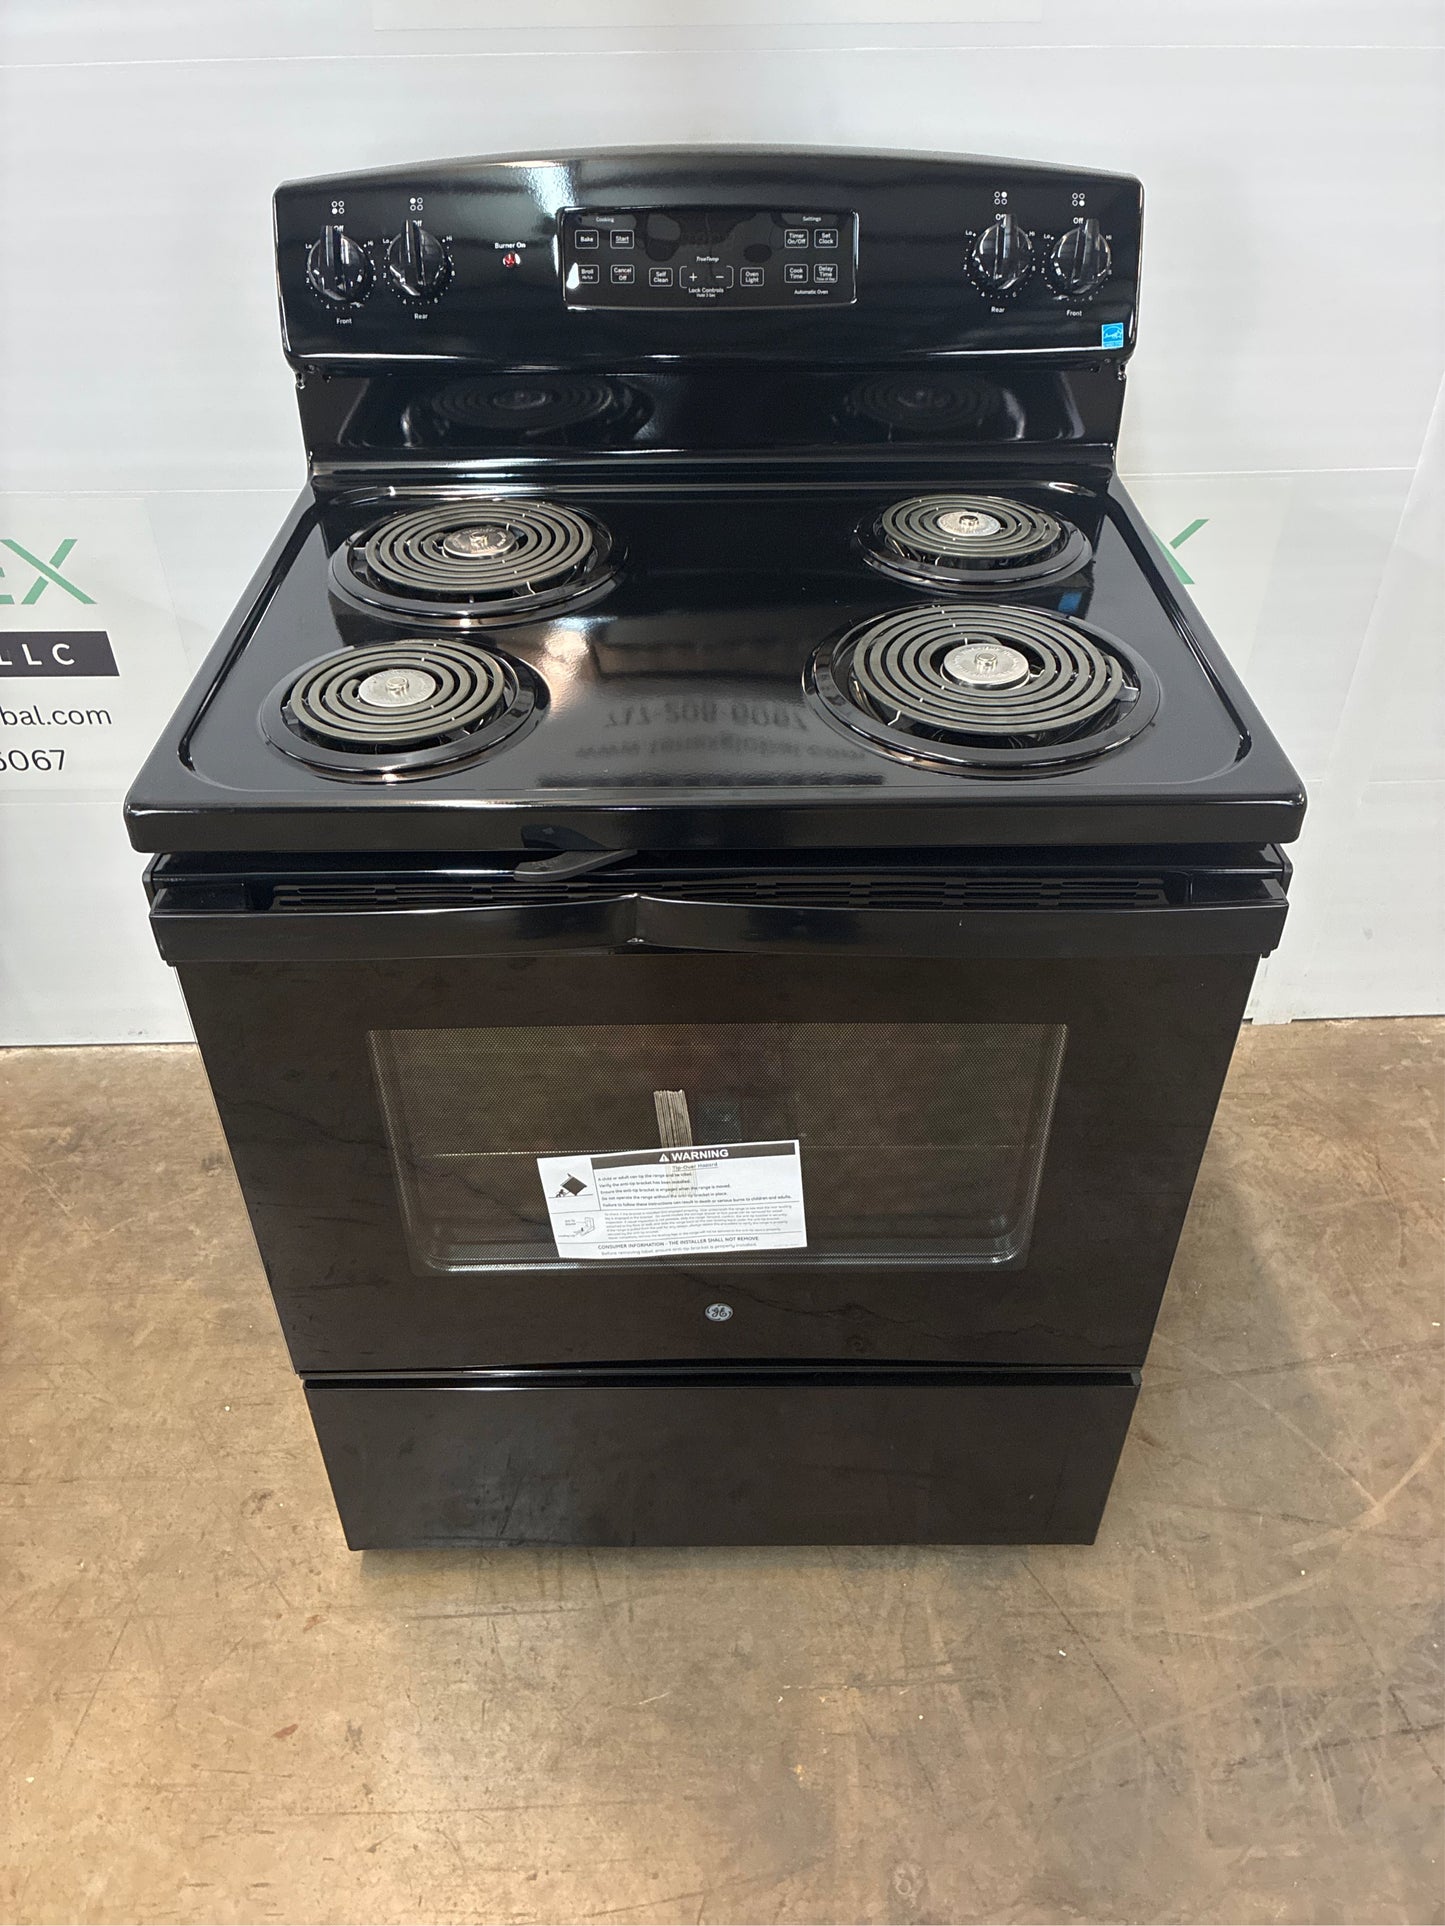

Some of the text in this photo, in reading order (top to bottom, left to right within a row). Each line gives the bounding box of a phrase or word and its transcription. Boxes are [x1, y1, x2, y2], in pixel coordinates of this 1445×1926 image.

[615, 235, 629, 243] Start
[336, 317, 352, 325] Front
[671, 1149, 729, 1162] WARNING
